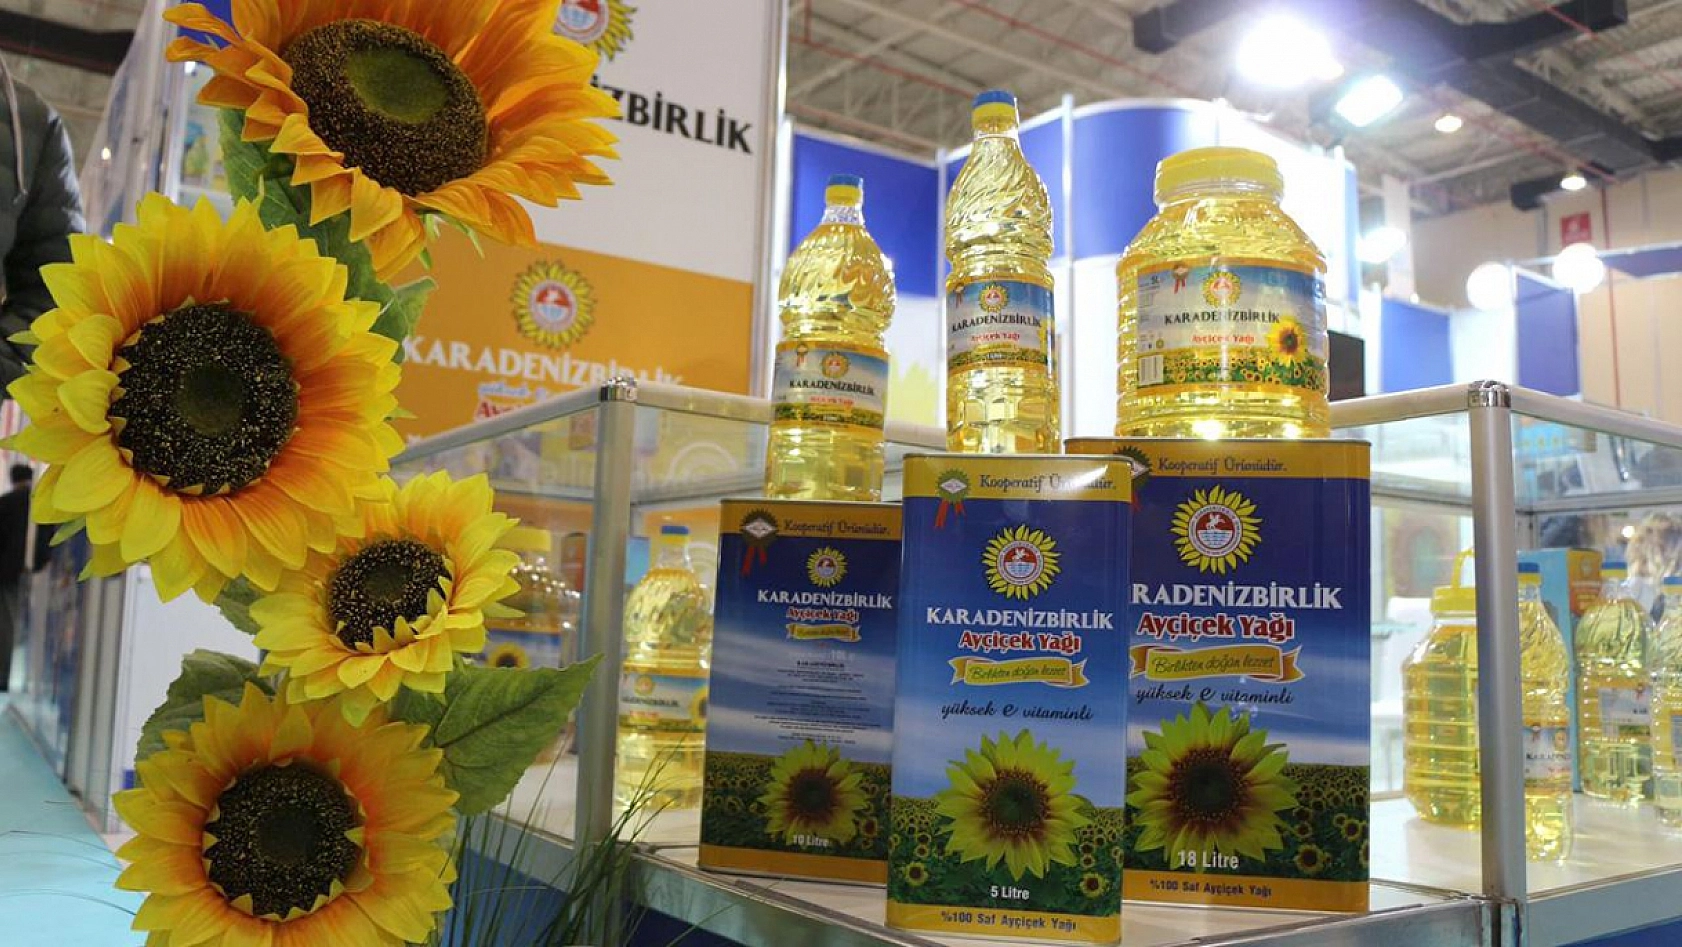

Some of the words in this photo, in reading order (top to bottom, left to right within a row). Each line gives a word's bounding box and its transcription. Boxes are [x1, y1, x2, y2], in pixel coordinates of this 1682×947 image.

[952, 312, 1041, 332] KARADENİZBİRLİK
[1158, 458, 1218, 474] Kooperatif
[979, 474, 1044, 493] Kooperatif
[757, 589, 893, 609] KARADENİZBİRLİK
[1131, 581, 1343, 609] RADENİZBİRLİK
[926, 607, 1114, 630] KARADENİZBİRLİK
[1137, 613, 1235, 642] Ayçiçek
[1239, 613, 1295, 643] Yağı
[959, 630, 1036, 653] Ayçiçek
[1037, 630, 1082, 656] Yağı
[1206, 653, 1240, 676] doğan
[1243, 653, 1275, 669] lezzet
[1136, 683, 1194, 704] yüksek
[1199, 687, 1216, 702] e
[1220, 688, 1295, 705] vitaminli
[941, 700, 997, 720] yüksek
[1002, 702, 1020, 716] e
[1022, 703, 1095, 721] vitaminli
[1178, 849, 1197, 867] 18
[1202, 851, 1240, 869] Litre
[991, 885, 998, 898] 5
[1002, 885, 1030, 900] Litre
[1150, 878, 1179, 891] %100
[1182, 881, 1200, 893] Saf
[1204, 882, 1244, 896] Ayçiçek
[1250, 884, 1272, 898] Yağı
[941, 911, 972, 924] %100
[977, 913, 996, 925] Saf
[1001, 914, 1046, 929] Ayçiçek
[1051, 917, 1077, 933] Yağı
